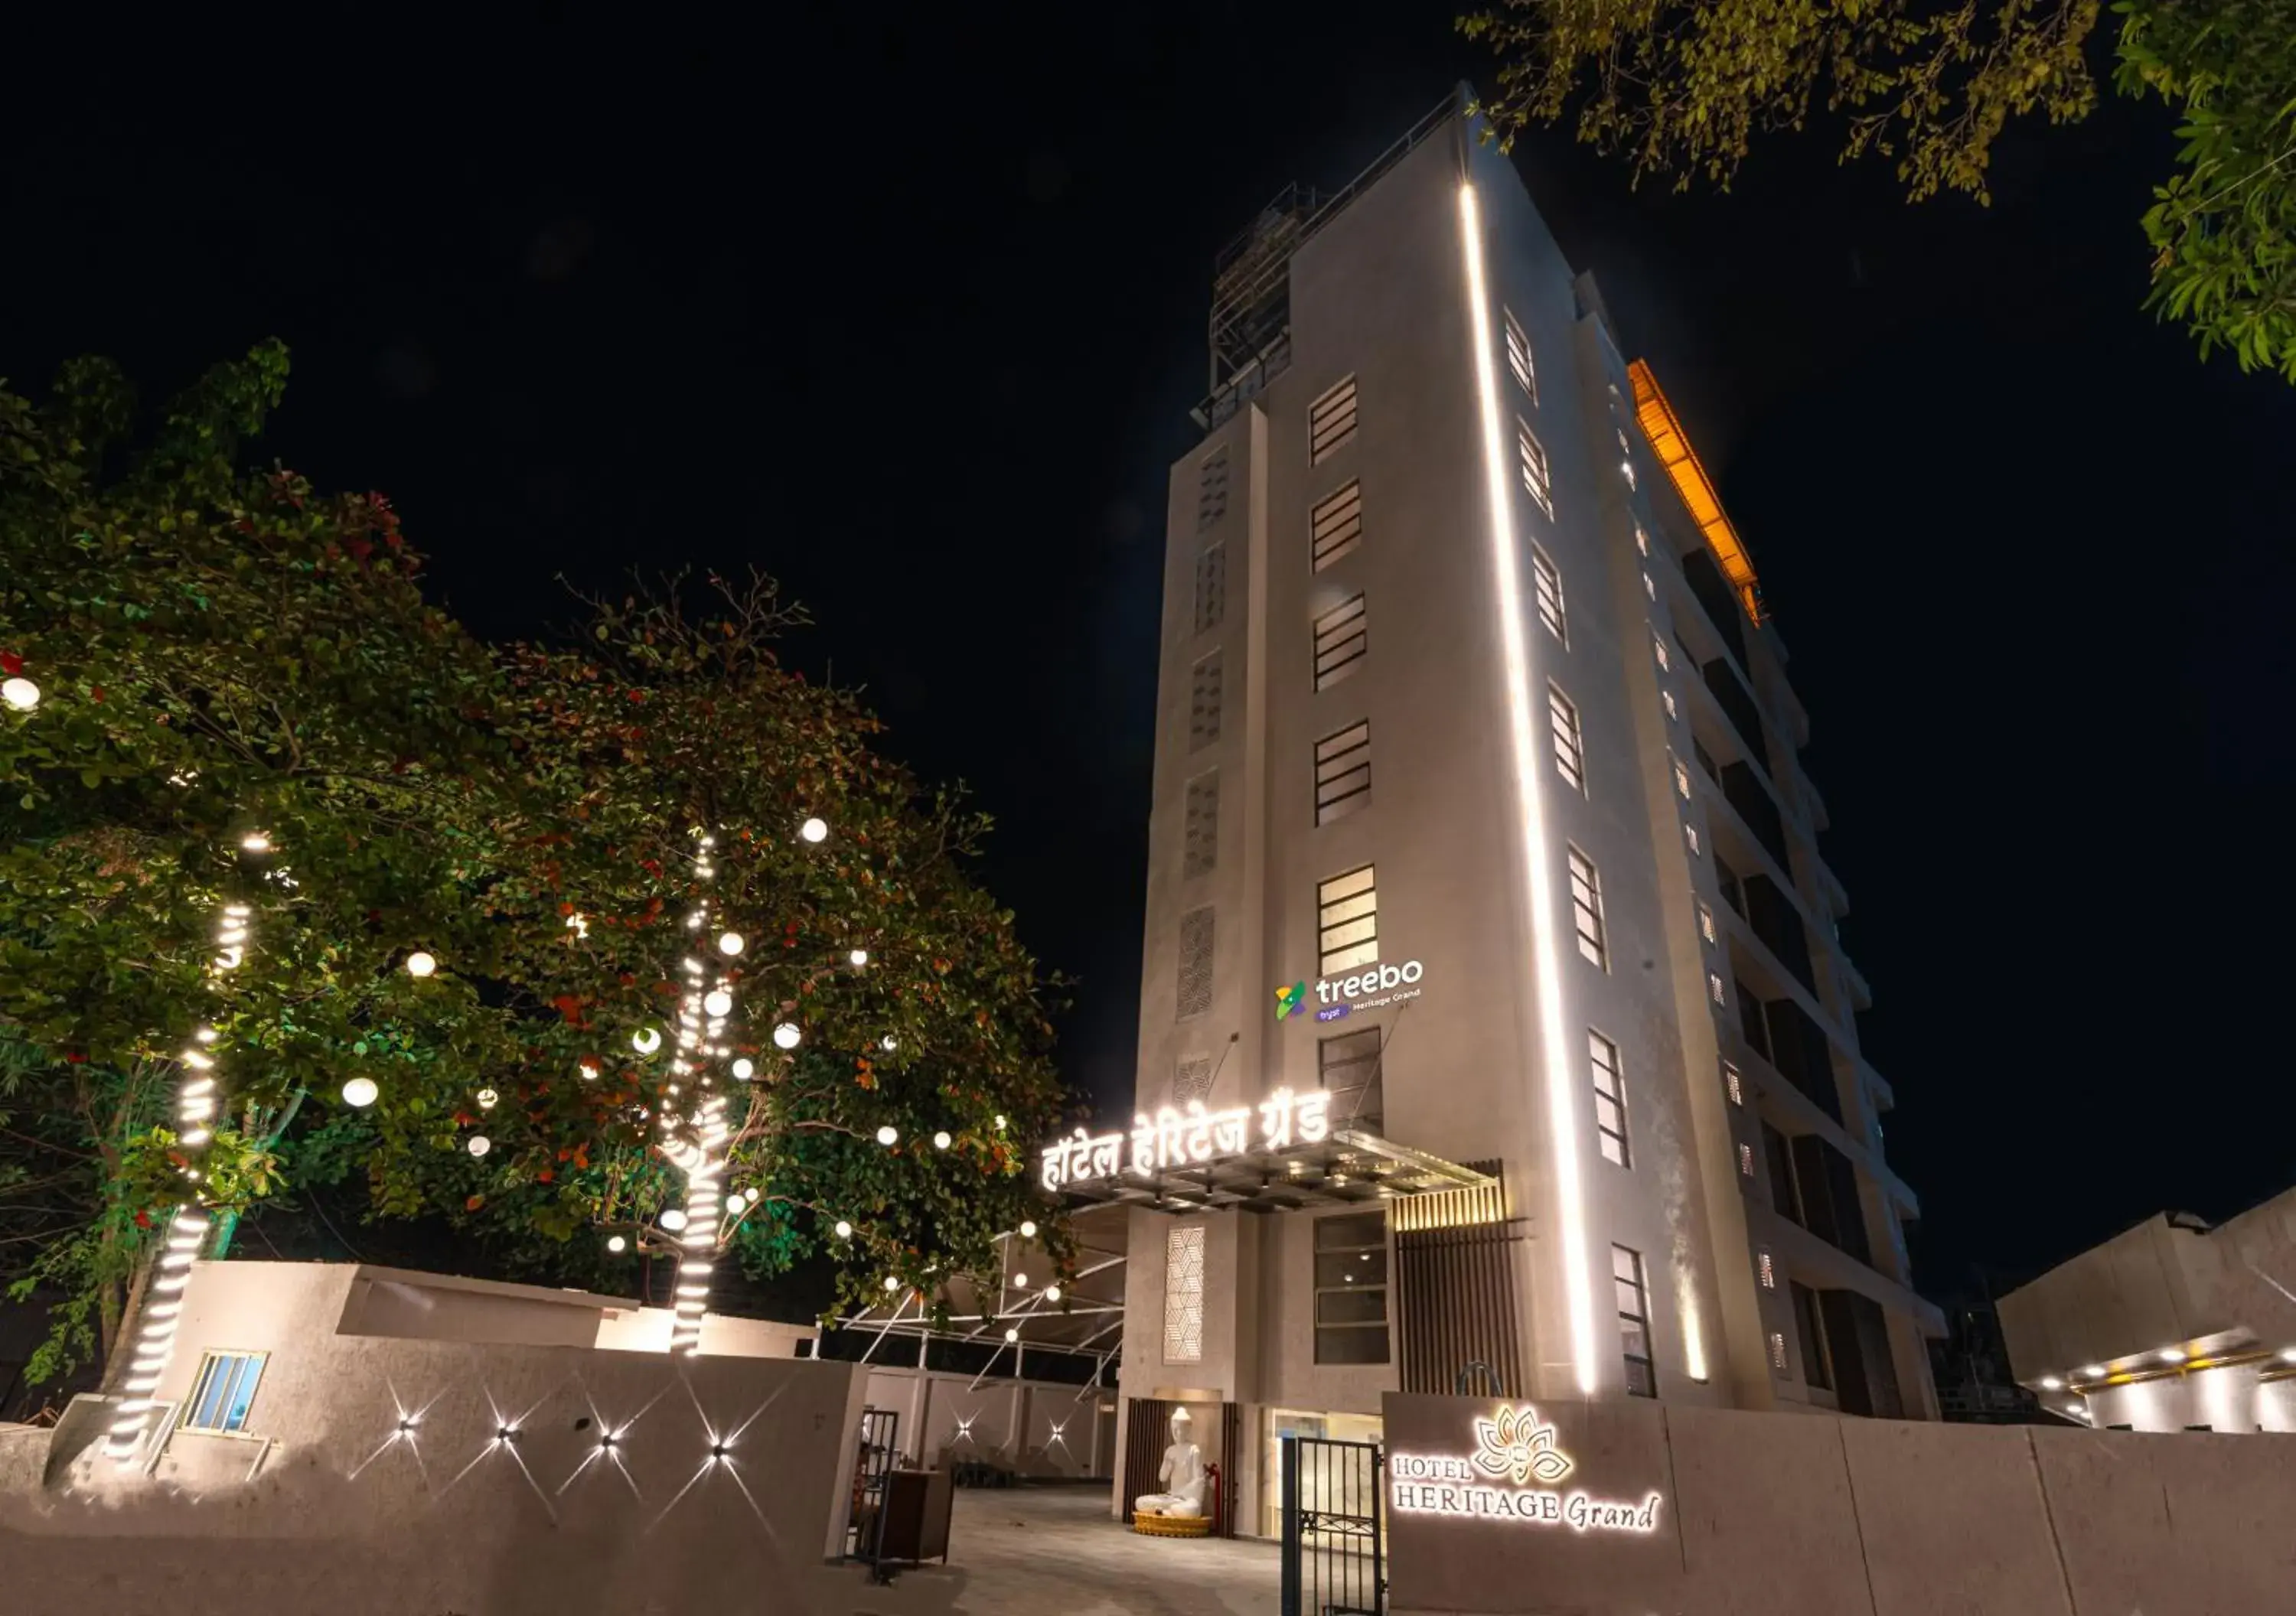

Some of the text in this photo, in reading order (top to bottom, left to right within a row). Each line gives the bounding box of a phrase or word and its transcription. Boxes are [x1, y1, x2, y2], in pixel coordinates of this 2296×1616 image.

[1316, 960, 1423, 1003] treebo
[1352, 996, 1391, 1011] Heritage
[1392, 988, 1421, 1002] Grand
[1042, 1127, 1123, 1191] हॉटेल
[1130, 1100, 1251, 1177] हेरिटेज
[1395, 1457, 1472, 1481] HOTEL
[1395, 1485, 1660, 1529] HERITAGE Grand
